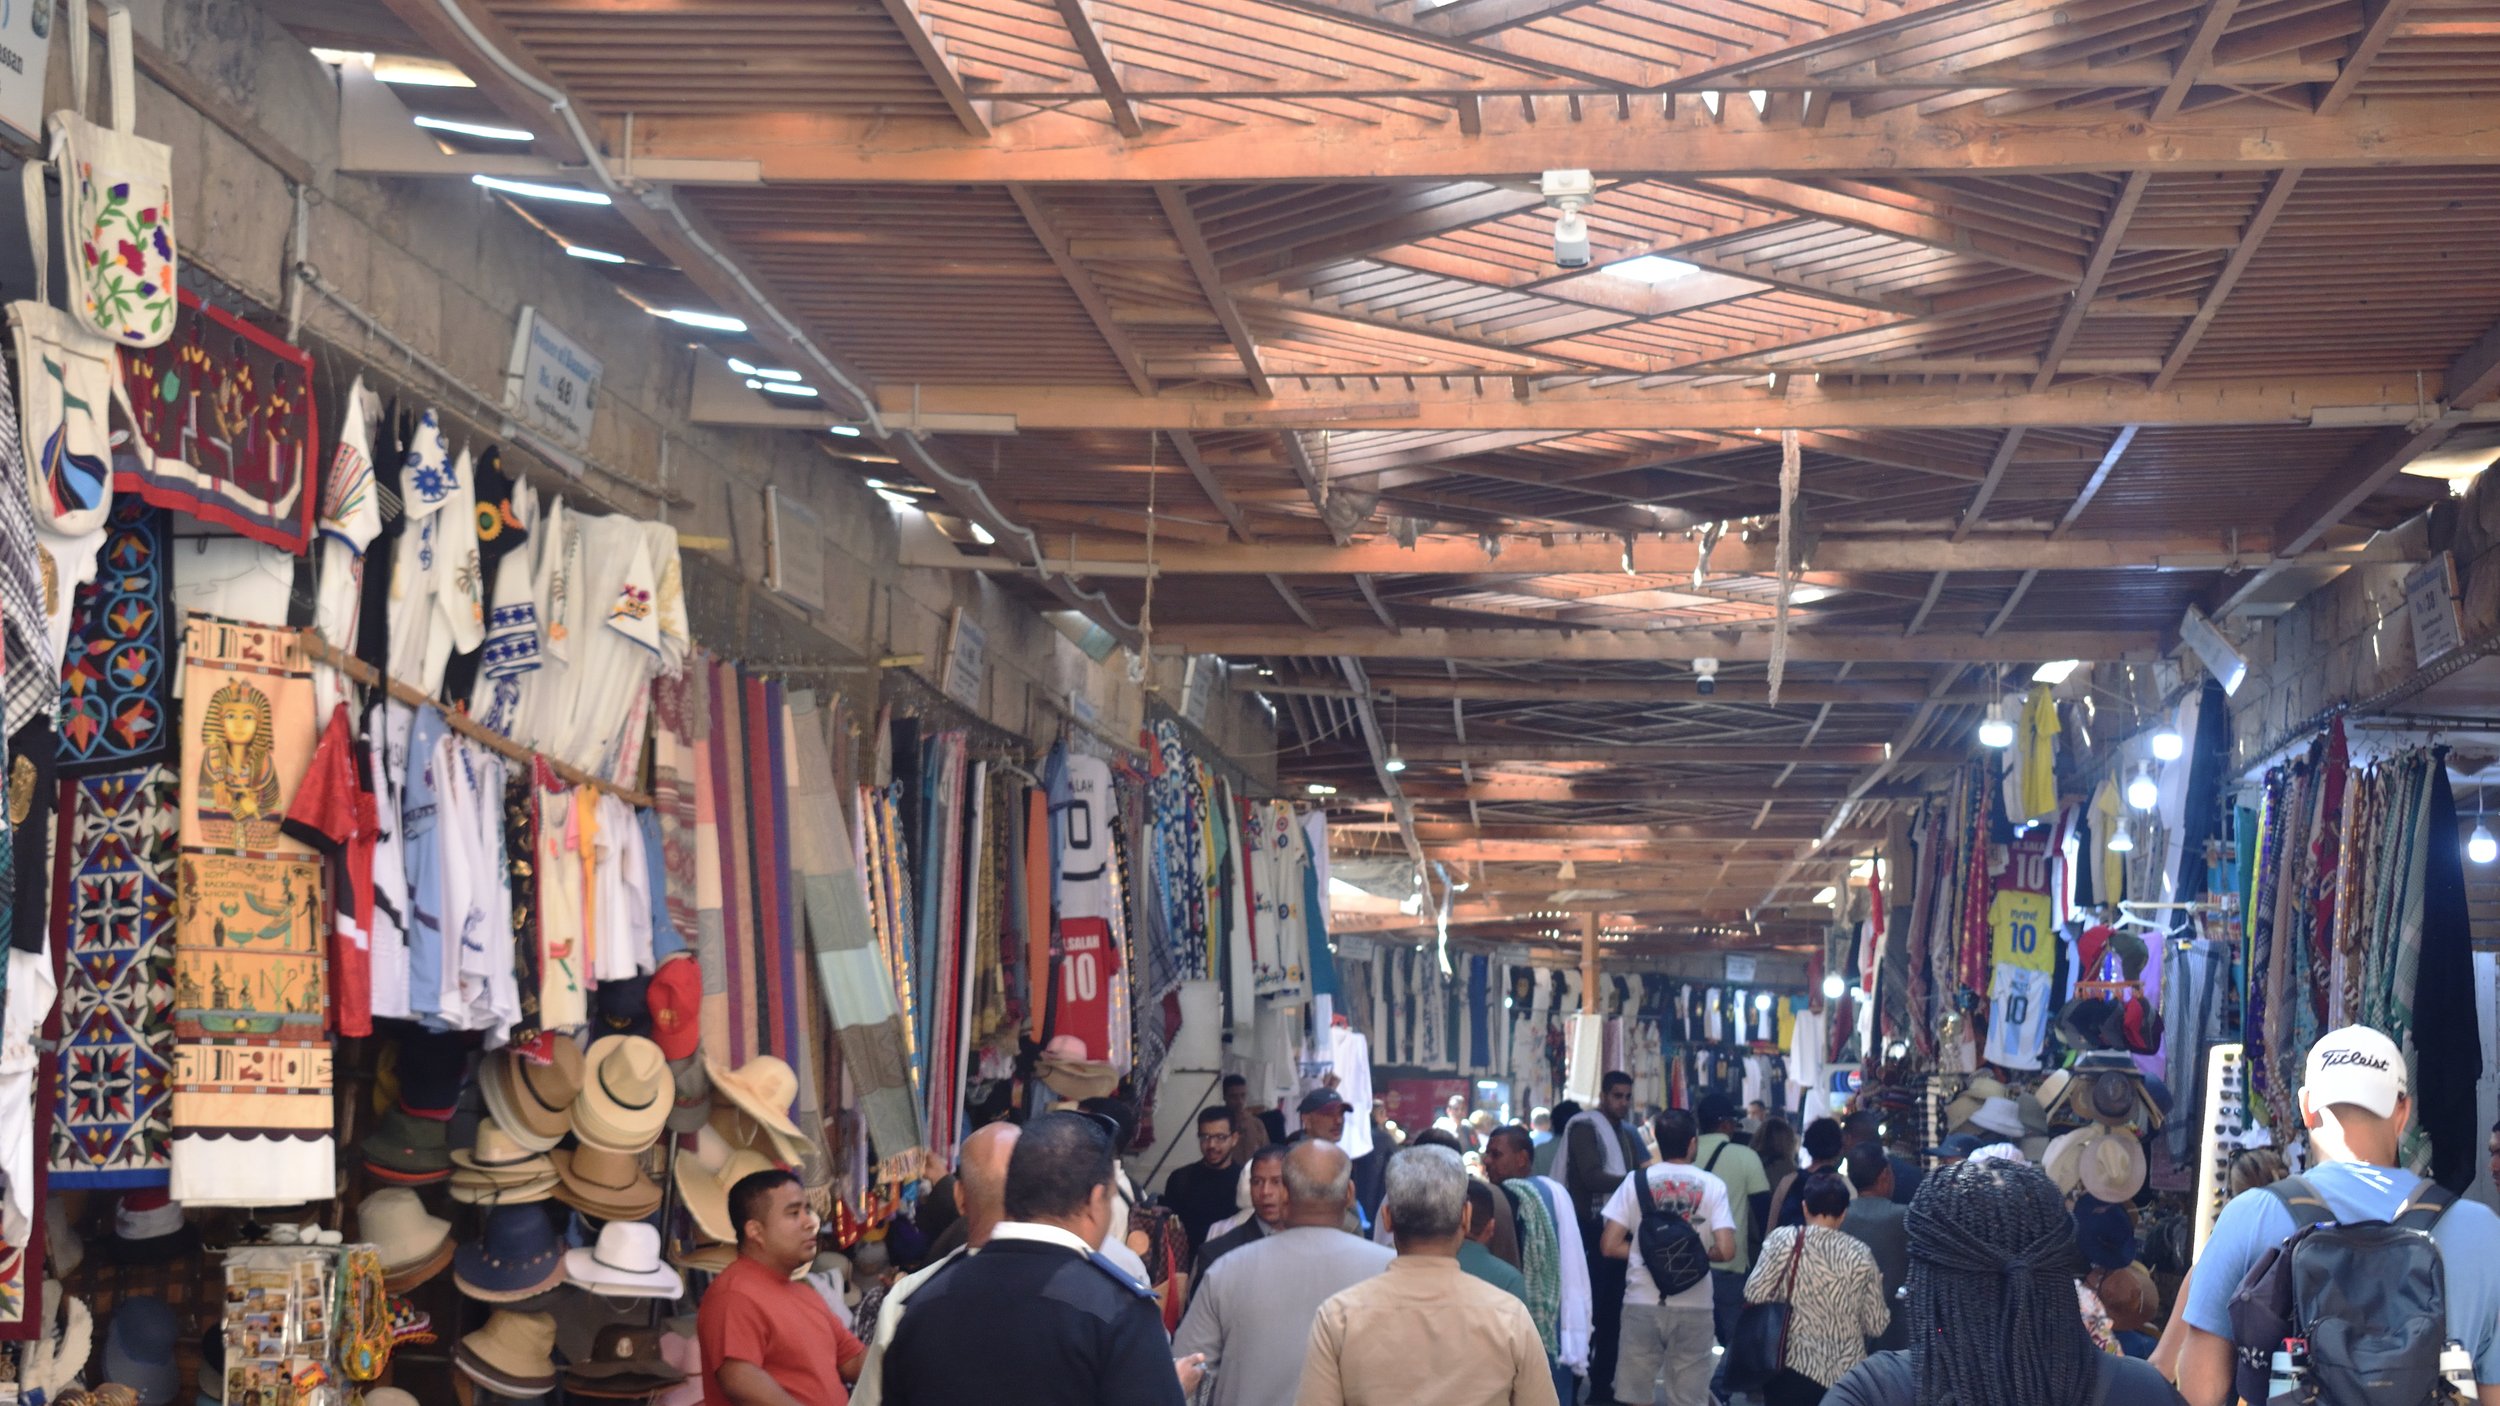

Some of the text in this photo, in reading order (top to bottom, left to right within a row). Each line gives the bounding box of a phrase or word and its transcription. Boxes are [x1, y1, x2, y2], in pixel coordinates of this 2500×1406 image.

[2016, 853, 2046, 890] 10
[2010, 922, 2037, 954] 10
[1062, 952, 1097, 1003] 10
[2005, 994, 2029, 1025] 10
[2321, 1048, 2390, 1072] Titleist
